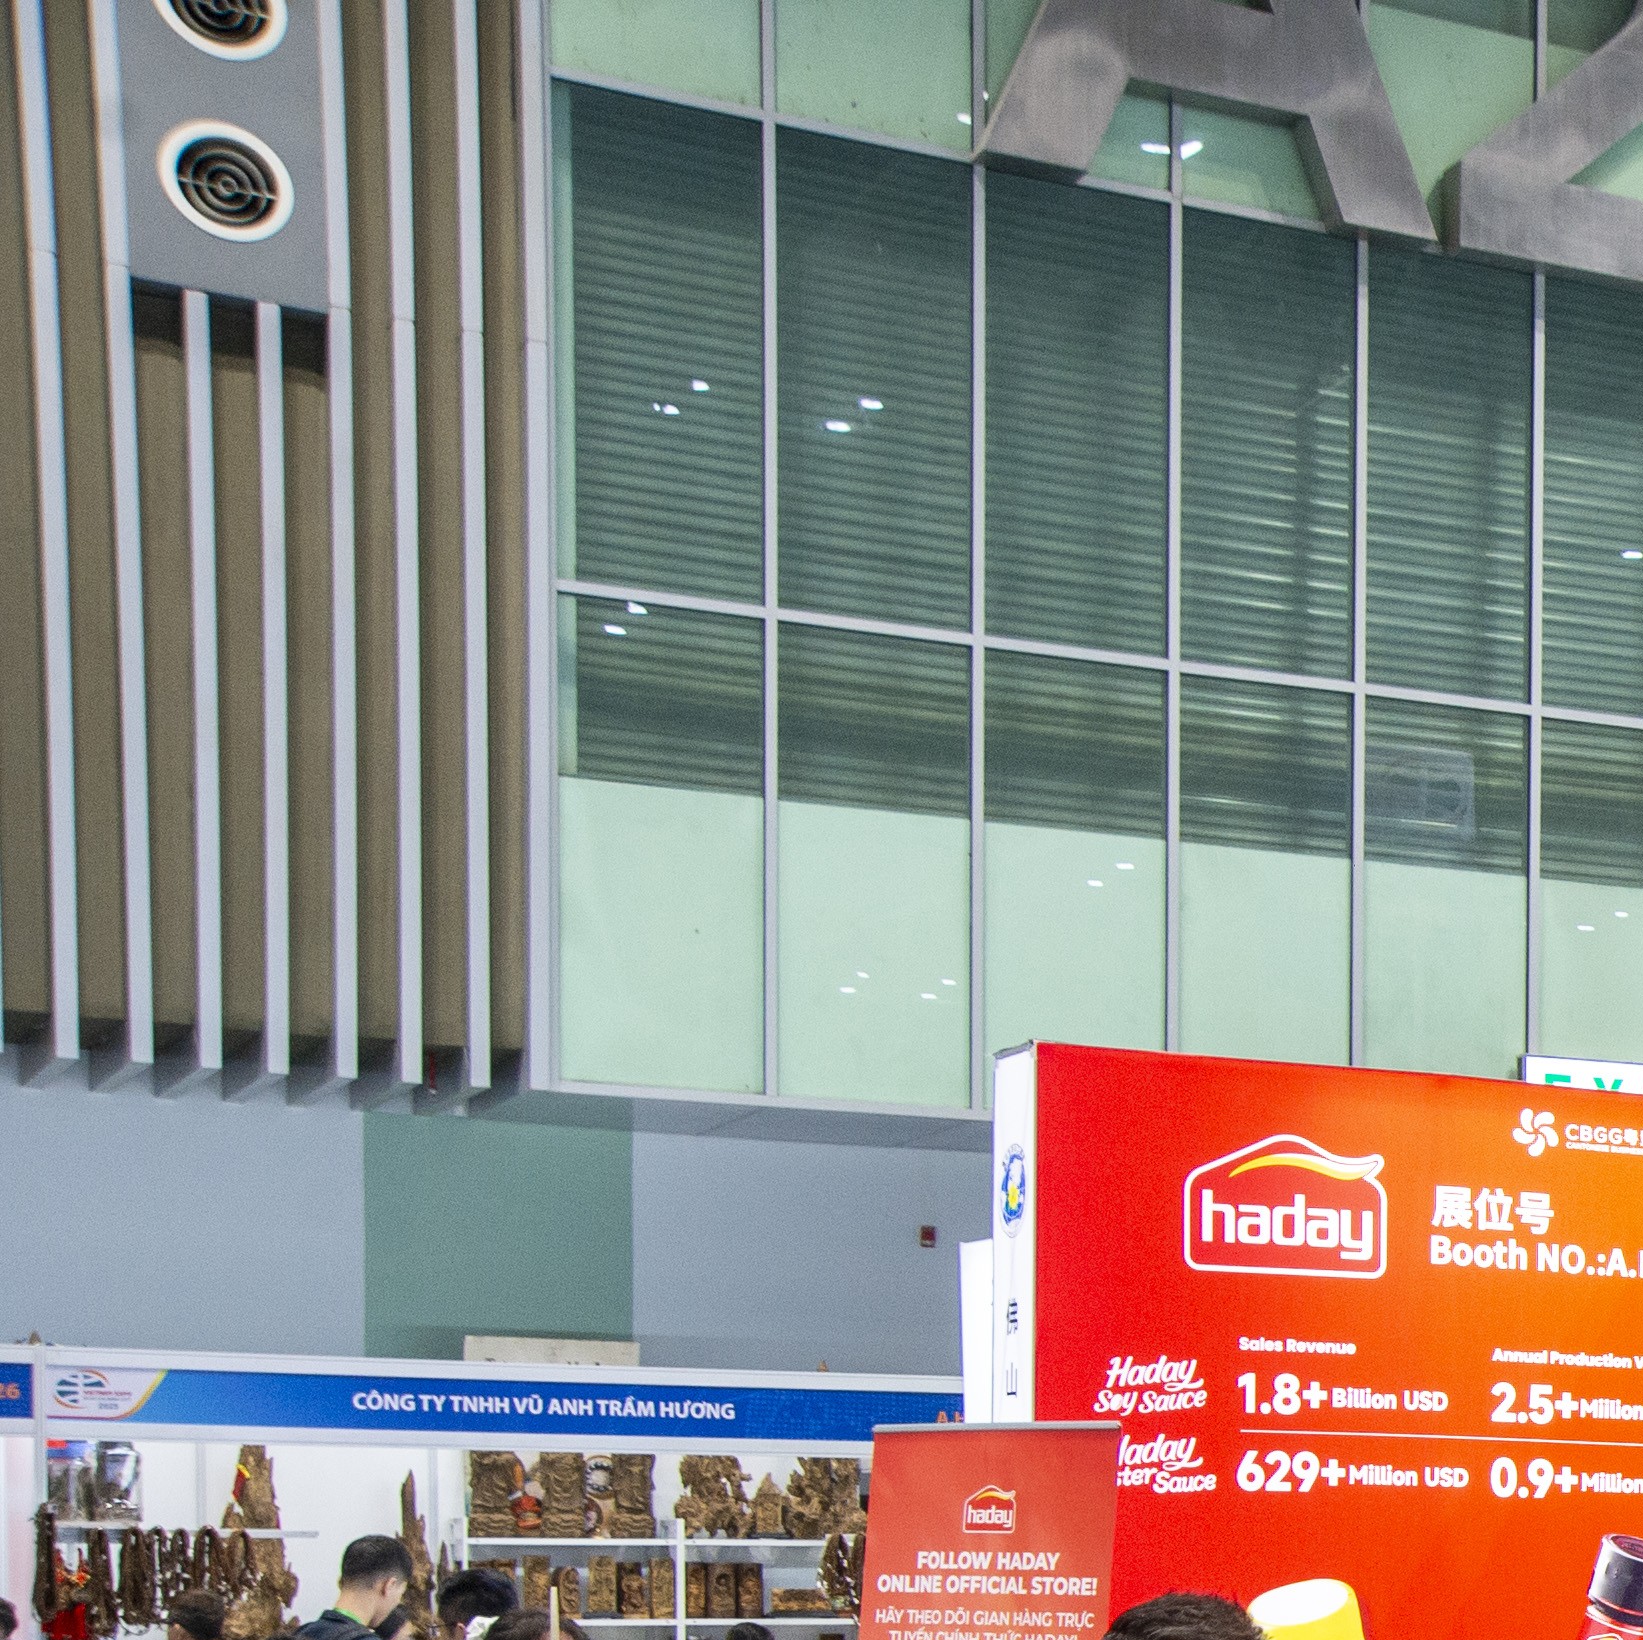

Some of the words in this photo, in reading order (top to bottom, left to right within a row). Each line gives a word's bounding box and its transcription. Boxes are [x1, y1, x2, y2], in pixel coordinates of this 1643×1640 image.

[1431, 1185, 1554, 1235] 展位号
[1200, 1187, 1374, 1261] haday
[1430, 1235, 1528, 1271] Booth
[1239, 1336, 1283, 1352] Sales
[1285, 1338, 1357, 1355] Revenue
[1492, 1348, 1547, 1364] Annual
[1550, 1350, 1632, 1369] Production
[1105, 1355, 1205, 1392] Haday
[352, 1390, 417, 1412] CÔNG
[419, 1395, 448, 1413] TY
[451, 1395, 509, 1415] TNHH
[512, 1392, 542, 1416] VŨ
[548, 1397, 594, 1417] ANH
[597, 1394, 655, 1419] TRẦM
[659, 1398, 736, 1420] HƯƠNG
[1094, 1389, 1137, 1417] Soy
[1139, 1388, 1208, 1415] Sauce
[1403, 1390, 1449, 1412] USD
[1152, 1471, 1217, 1494] Sauce
[1425, 1467, 1470, 1488] USD
[967, 1505, 1013, 1528] haday
[917, 1551, 992, 1570] FOLLOW
[997, 1552, 1060, 1571] HADAY
[877, 1575, 942, 1594] ONLINE
[946, 1575, 1027, 1595] OFFICIAL
[1031, 1577, 1098, 1596] STORE!
[907, 1609, 942, 1625] THEO
[973, 1611, 1009, 1626] GIAN
[1013, 1607, 1053, 1628] HÀNG
[1057, 1611, 1095, 1631] TRỰC
